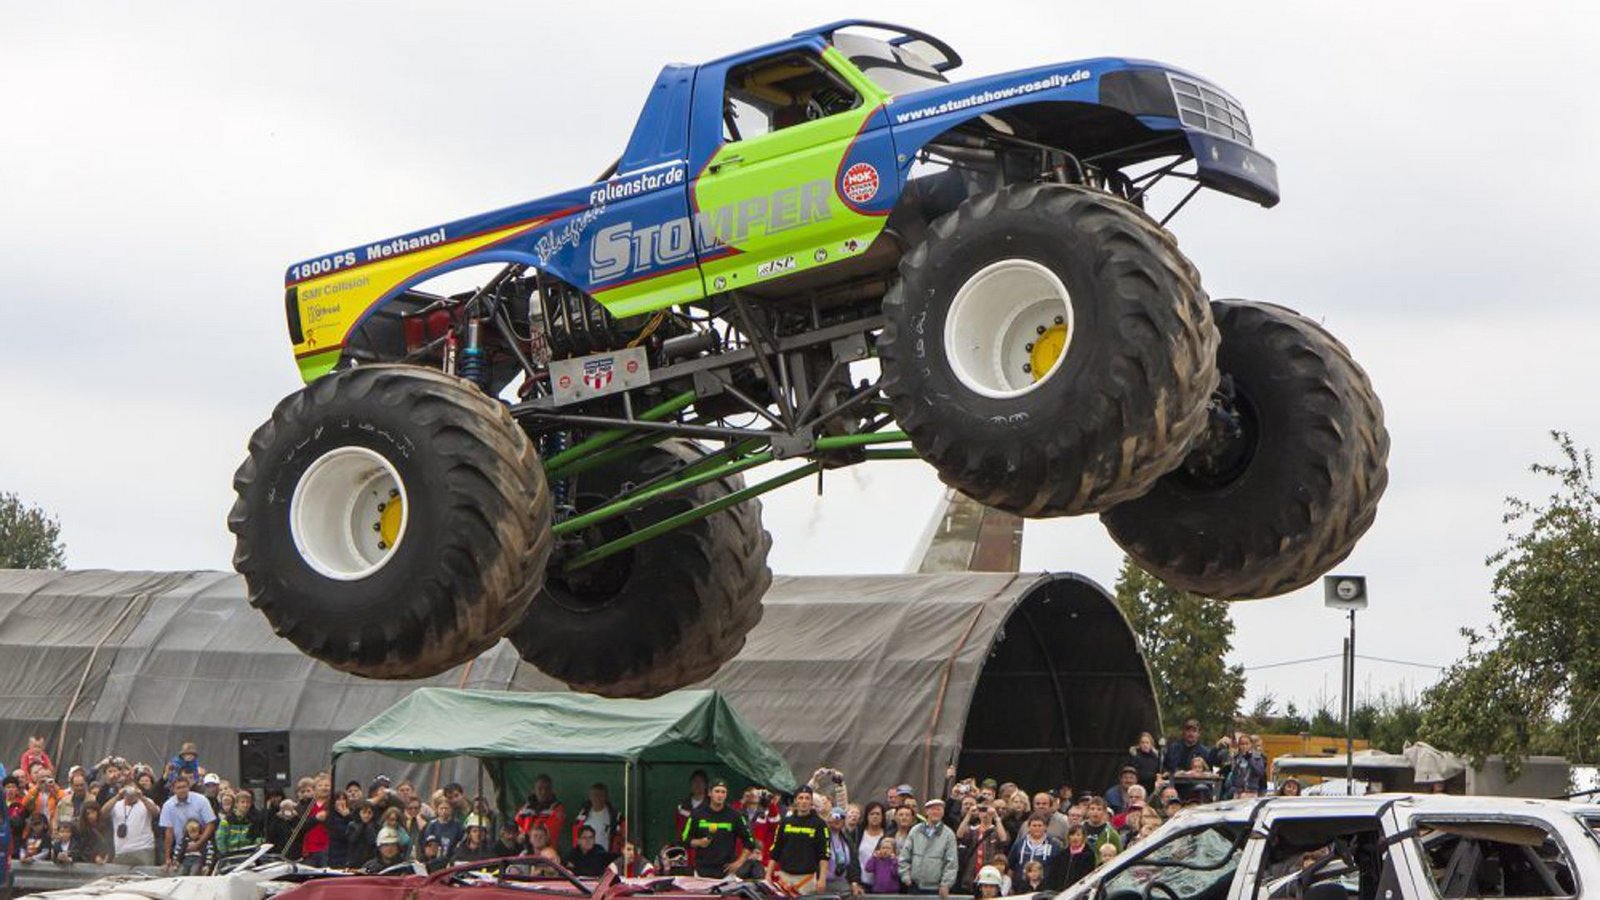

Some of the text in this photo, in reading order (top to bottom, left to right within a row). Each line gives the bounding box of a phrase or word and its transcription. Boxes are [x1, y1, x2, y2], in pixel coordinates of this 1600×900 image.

[292, 228, 446, 280] 1800 PS Methanol
